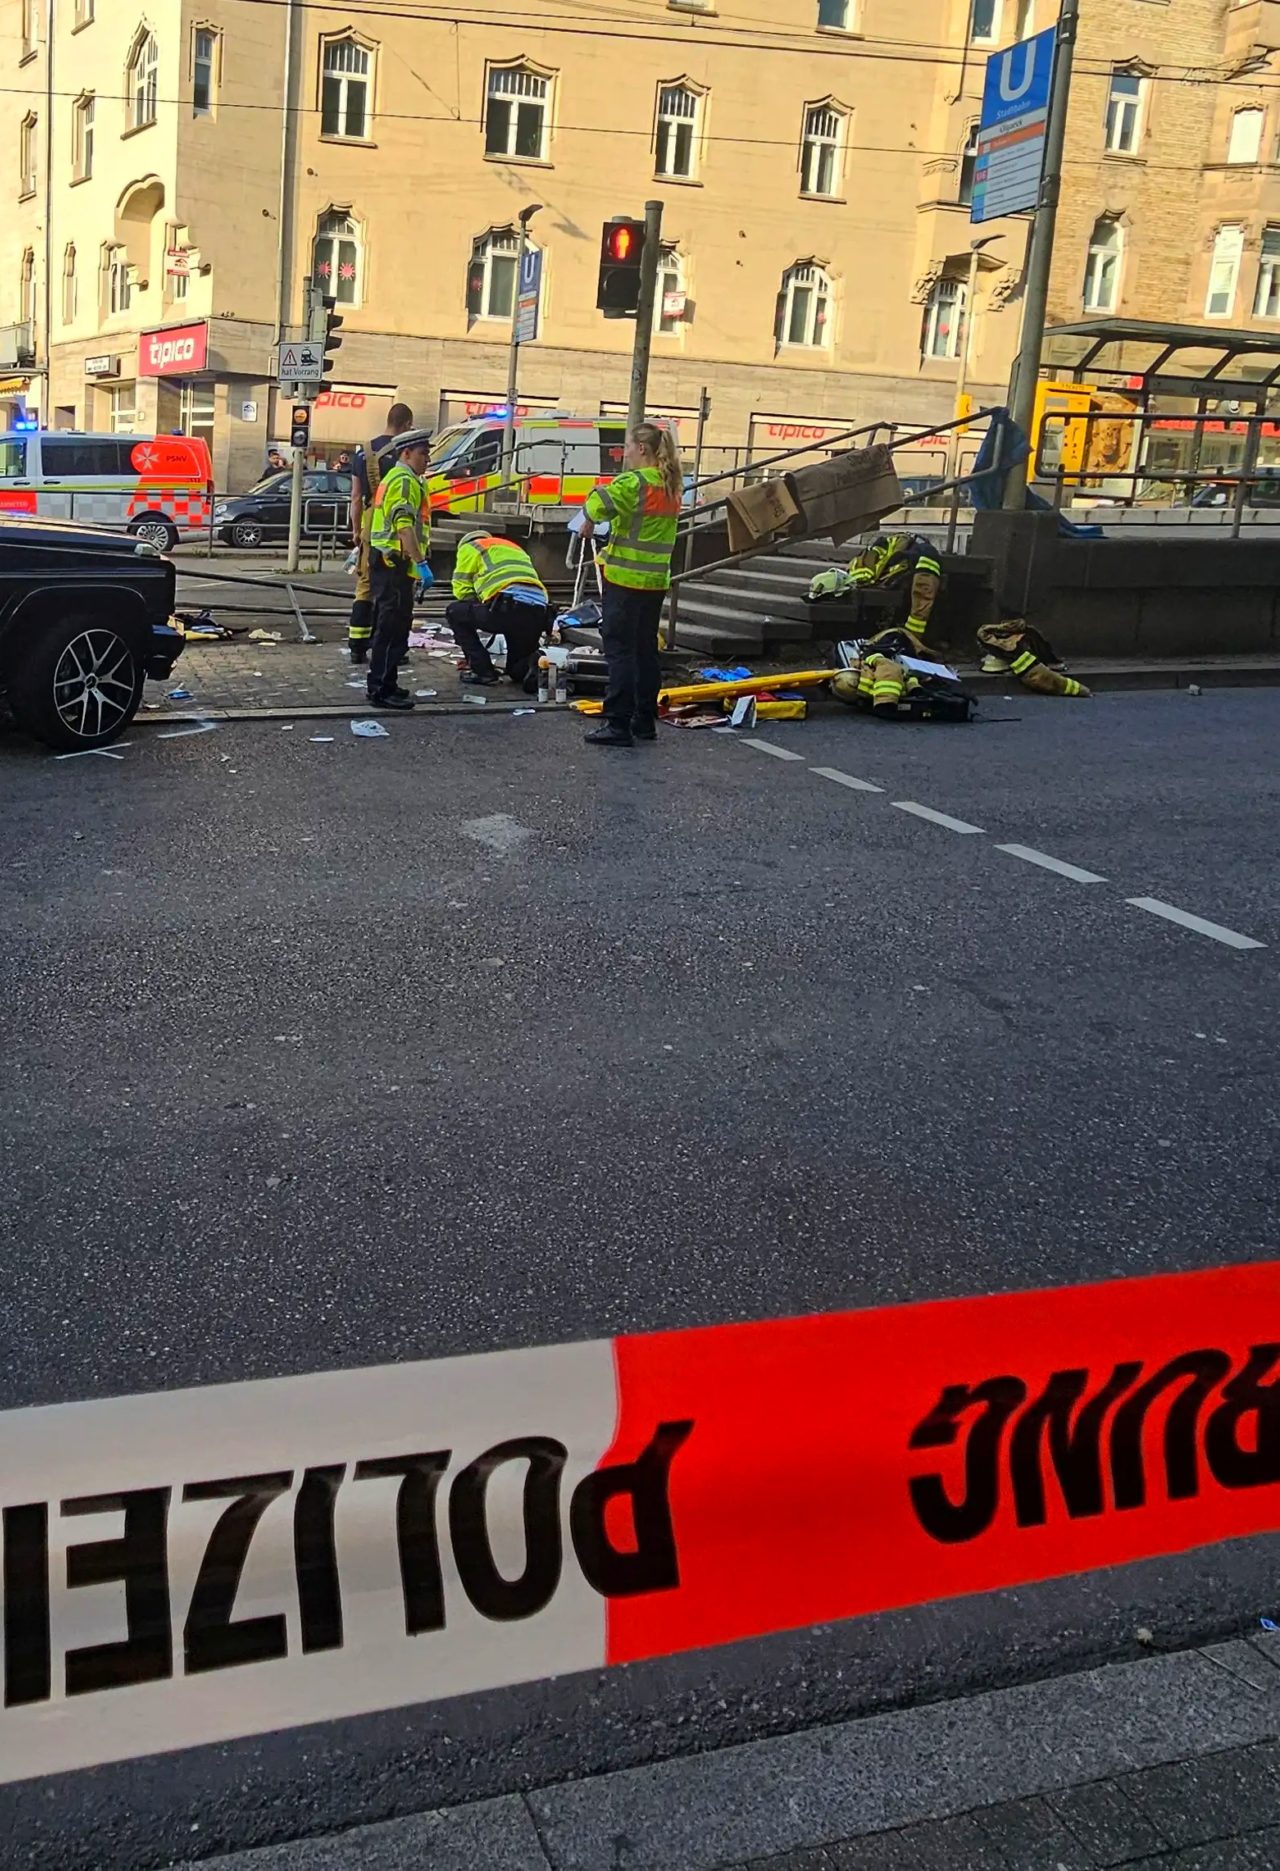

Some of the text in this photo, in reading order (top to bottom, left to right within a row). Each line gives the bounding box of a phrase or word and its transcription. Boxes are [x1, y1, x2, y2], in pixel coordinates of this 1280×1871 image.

[1000, 39, 1037, 101] U
[523, 255, 536, 284] U
[149, 335, 195, 369] tipico
[281, 368, 319, 377] hat Vorrang
[315, 390, 366, 410] pico
